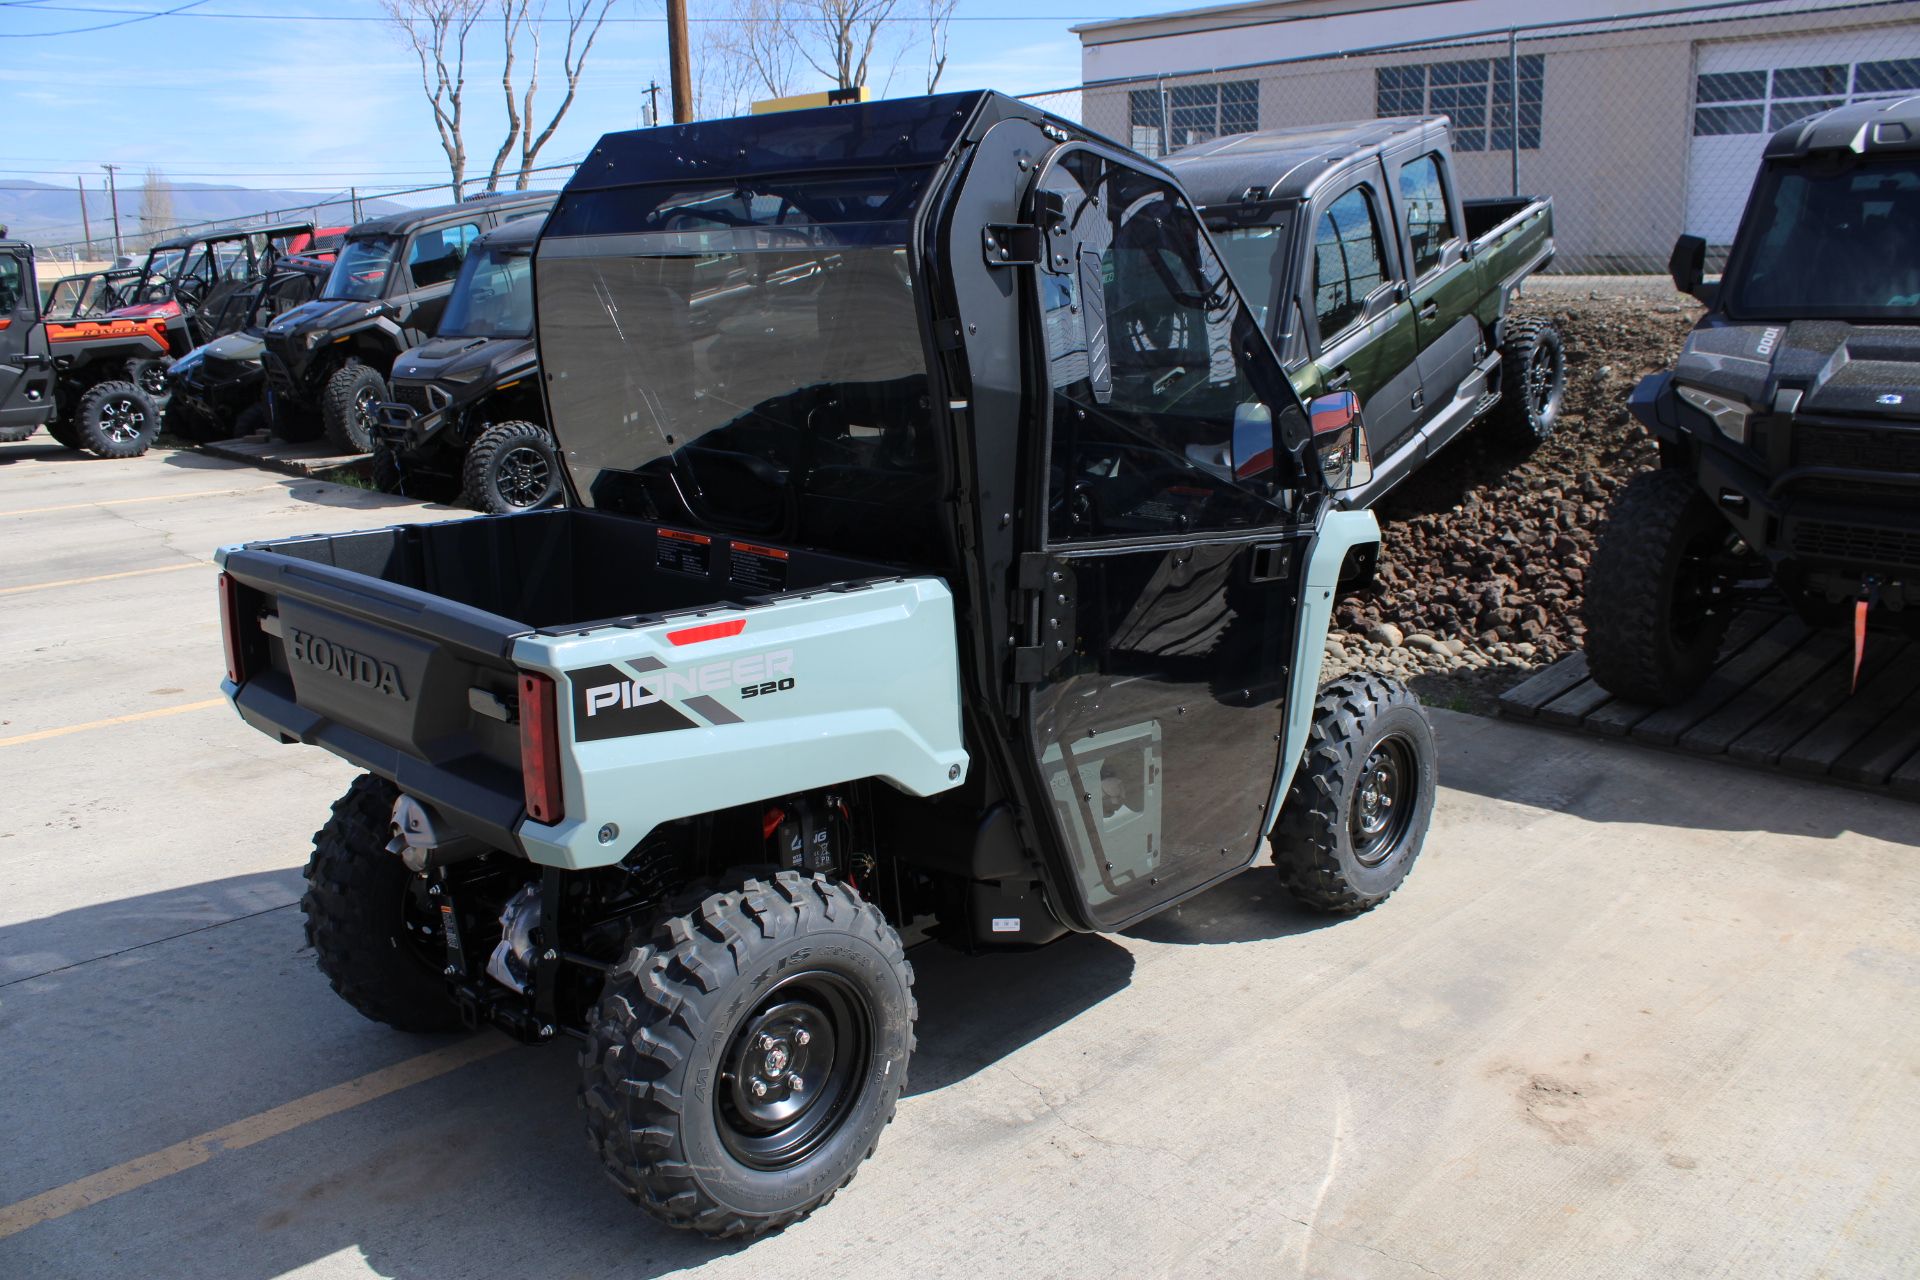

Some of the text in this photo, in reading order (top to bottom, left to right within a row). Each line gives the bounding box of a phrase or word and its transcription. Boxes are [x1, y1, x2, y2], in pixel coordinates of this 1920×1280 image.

[364, 305, 382, 316] XP
[83, 326, 139, 336] RANGER
[1756, 327, 1780, 355] 1000
[288, 627, 409, 702] HONDA
[586, 648, 796, 718] PIONEER
[740, 677, 795, 700] 520
